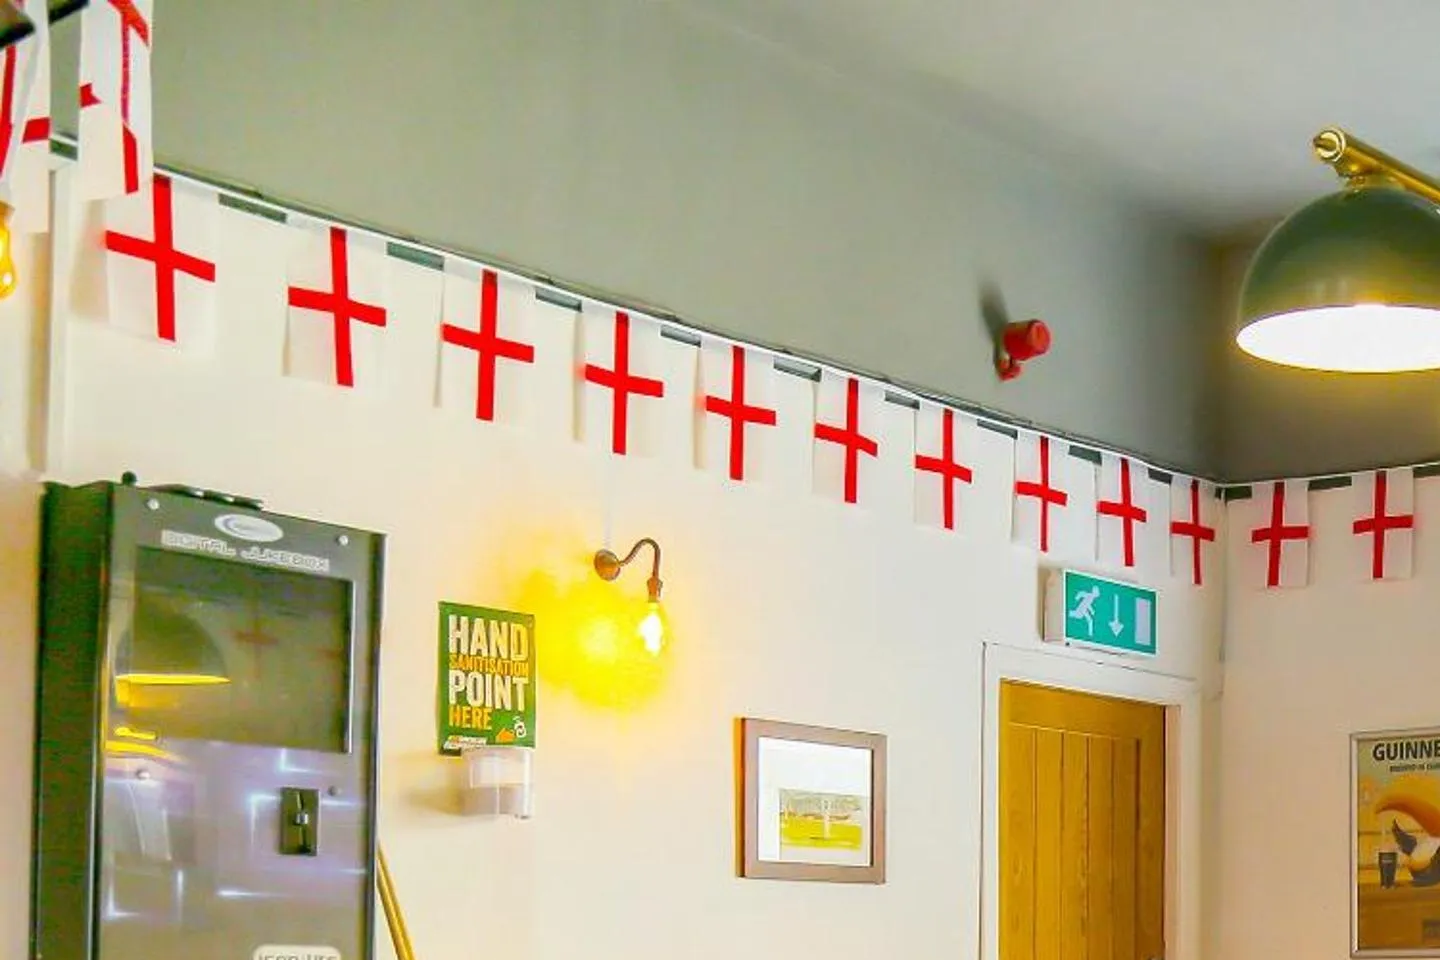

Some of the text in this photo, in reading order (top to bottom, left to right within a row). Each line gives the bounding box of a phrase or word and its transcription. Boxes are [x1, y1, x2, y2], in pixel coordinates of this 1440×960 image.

[448, 613, 529, 661] HAND
[448, 653, 530, 678] SANITISATION
[448, 669, 529, 712] POINT
[448, 703, 493, 731] HERE
